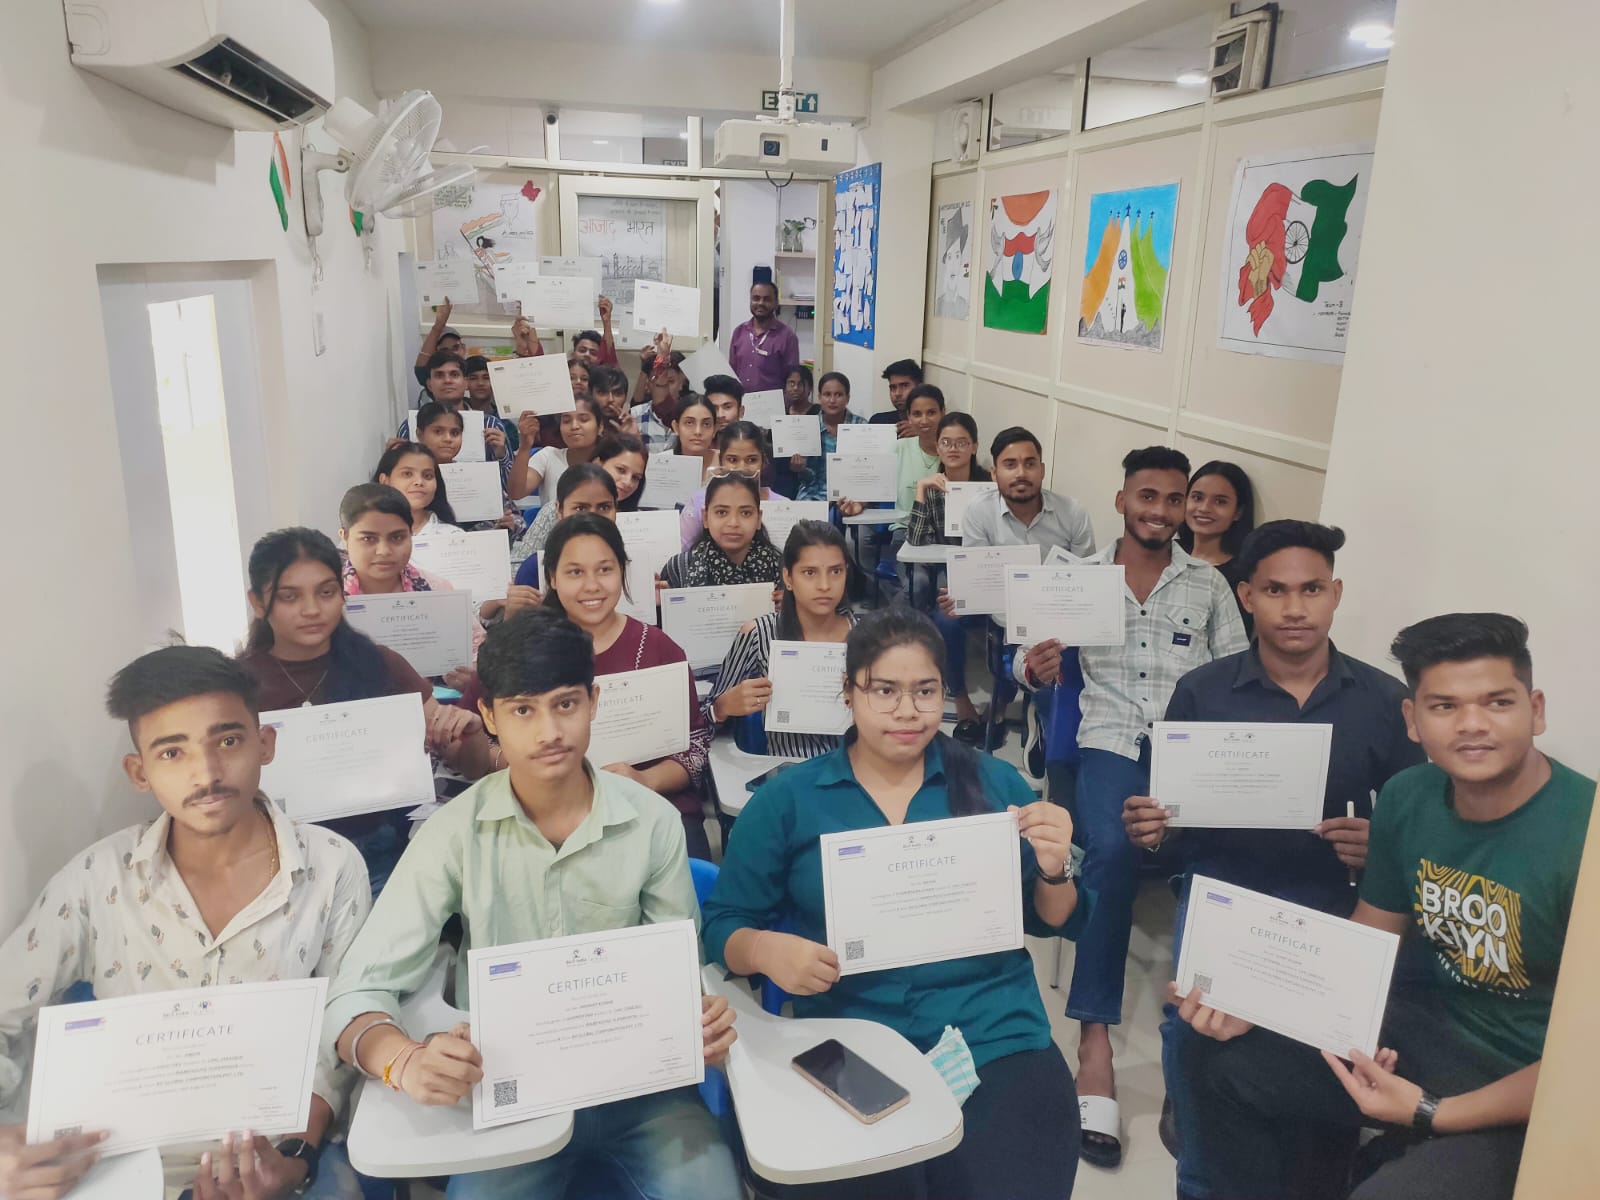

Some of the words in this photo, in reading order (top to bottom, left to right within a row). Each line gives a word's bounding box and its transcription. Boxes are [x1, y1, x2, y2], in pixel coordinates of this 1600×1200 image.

[764, 93, 806, 110] ET
[597, 694, 644, 708] ERTIFICATE
[305, 728, 369, 744] CERTIFICATE
[1208, 750, 1271, 760] CERTIFICATE
[887, 855, 957, 873] CERTIFICATE
[1422, 880, 1508, 938] BROO
[1249, 926, 1322, 956] CERTIFICATE
[547, 971, 629, 994] CERTIFICATE
[135, 1024, 235, 1047] CERTIFICATE
